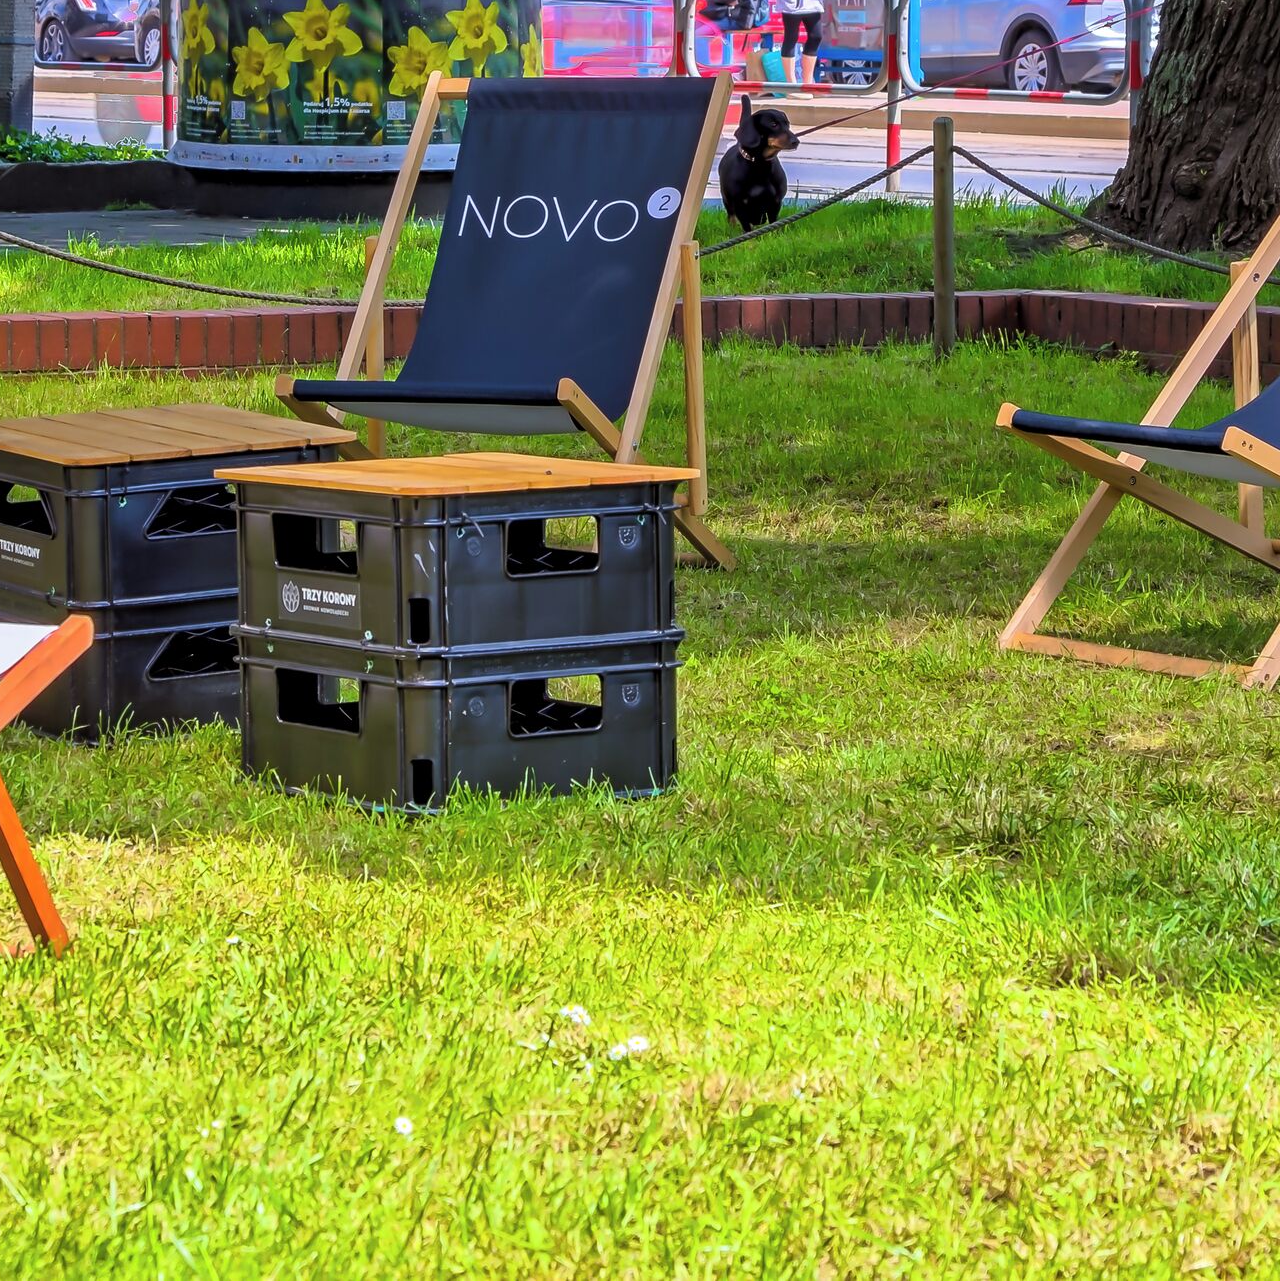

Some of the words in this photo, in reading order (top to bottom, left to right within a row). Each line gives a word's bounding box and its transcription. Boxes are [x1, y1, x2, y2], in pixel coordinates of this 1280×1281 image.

[325, 97, 350, 108] 1,5%
[458, 194, 640, 242] NOVO
[0, 538, 14, 552] TRZY
[14, 543, 40, 559] KORONY
[302, 588, 322, 602] TRZY
[322, 590, 356, 606] KORONY
